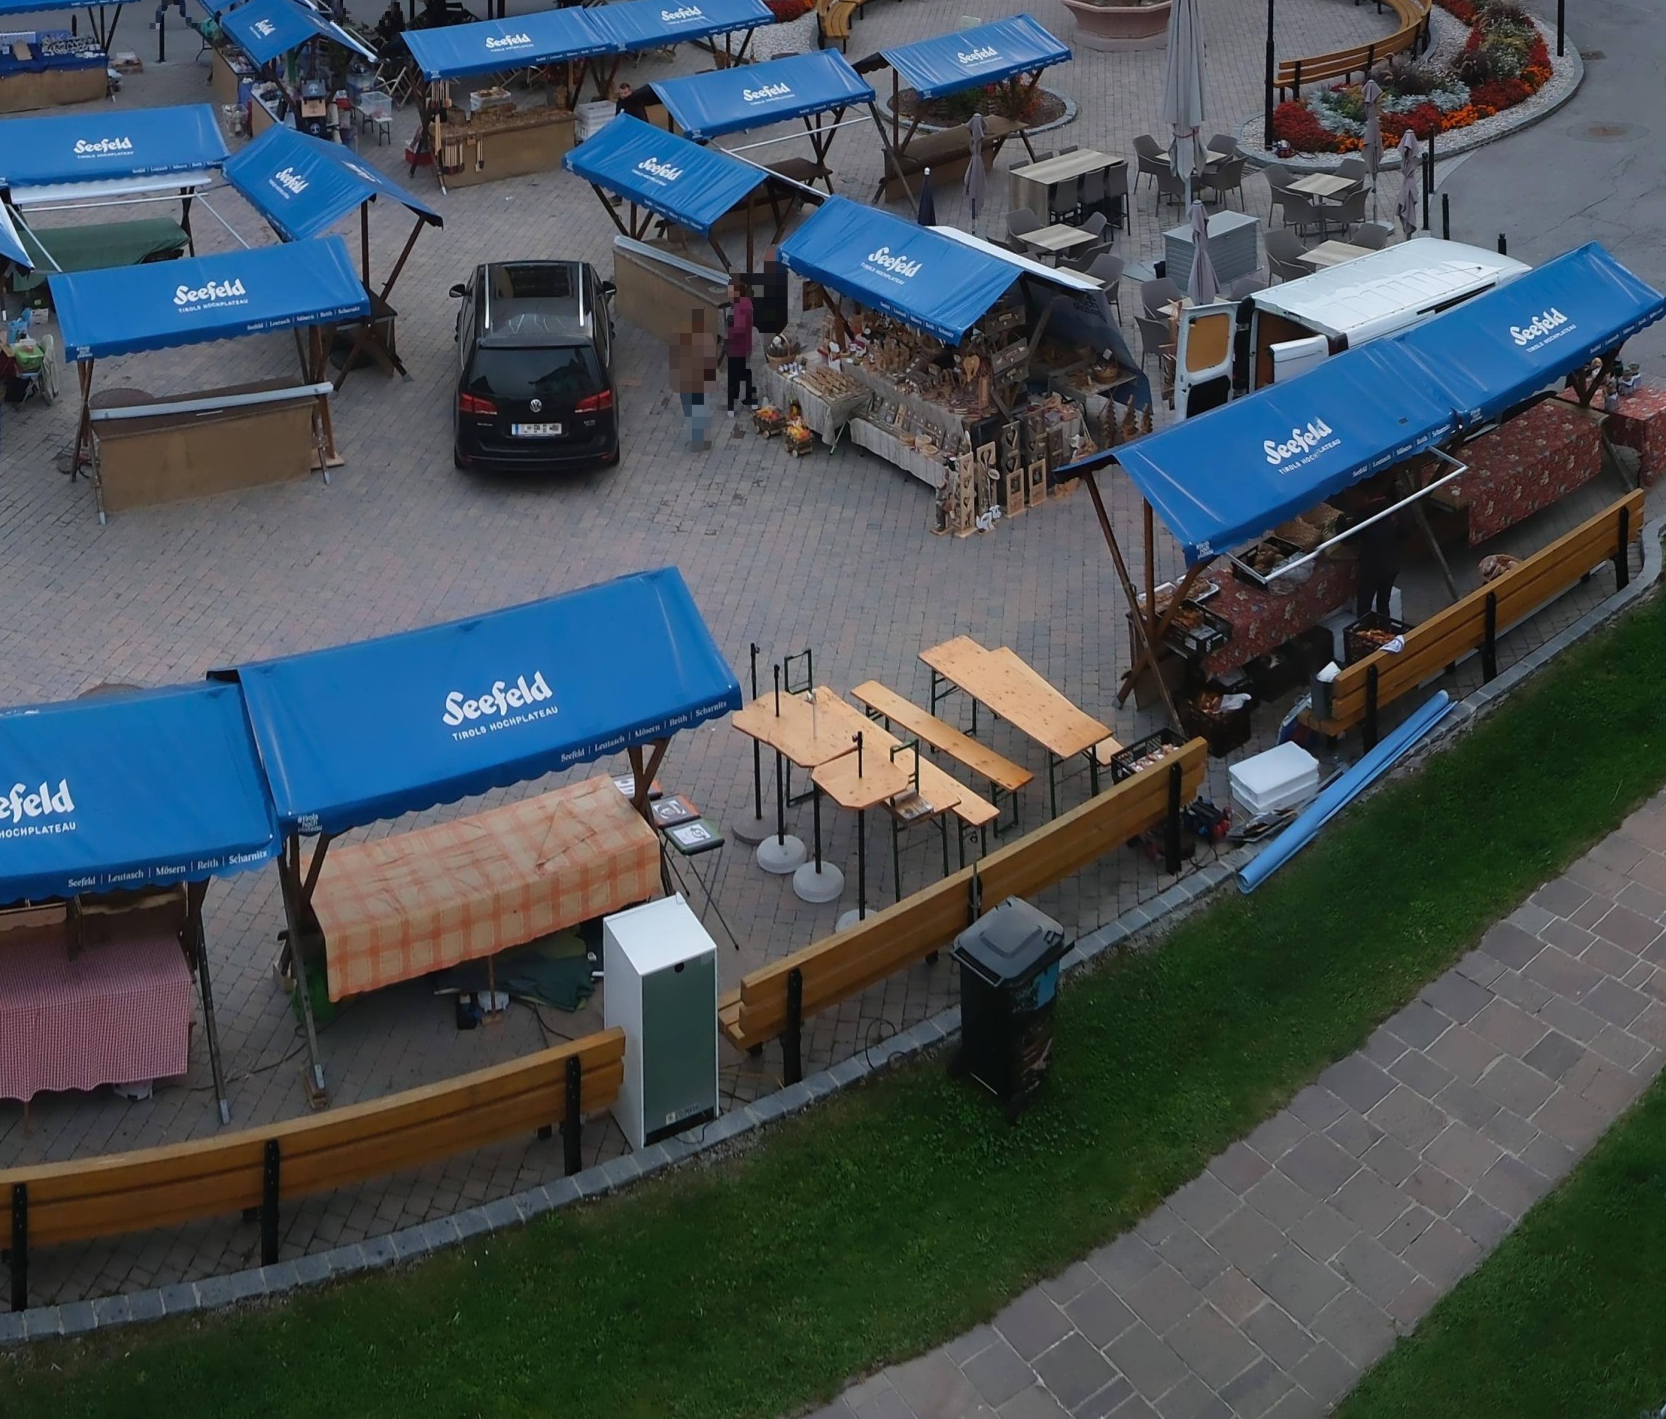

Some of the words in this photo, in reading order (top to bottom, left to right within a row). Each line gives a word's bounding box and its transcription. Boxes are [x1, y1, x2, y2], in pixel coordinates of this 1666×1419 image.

[661, 5, 702, 21] Seefeld
[485, 33, 531, 49] Seefeld
[957, 46, 998, 64] Seefeld
[742, 82, 791, 101] Seefeld
[73, 136, 133, 154] Seefeld
[638, 157, 684, 181] Seefeld
[868, 245, 923, 278] Seefeld
[173, 278, 247, 305] Seefeld
[1509, 307, 1568, 347] Seefeld
[1263, 416, 1333, 465] Seefeld
[442, 670, 554, 727] Seefeld
[451, 725, 487, 741] TIROLS
[489, 706, 559, 731] HOCHPLATEAU
[67, 874, 96, 888] Seefeld
[107, 868, 144, 883] Leutasch
[155, 862, 186, 877] Mösern
[197, 857, 219, 871] Reith
[228, 848, 268, 865] Scharnitz
